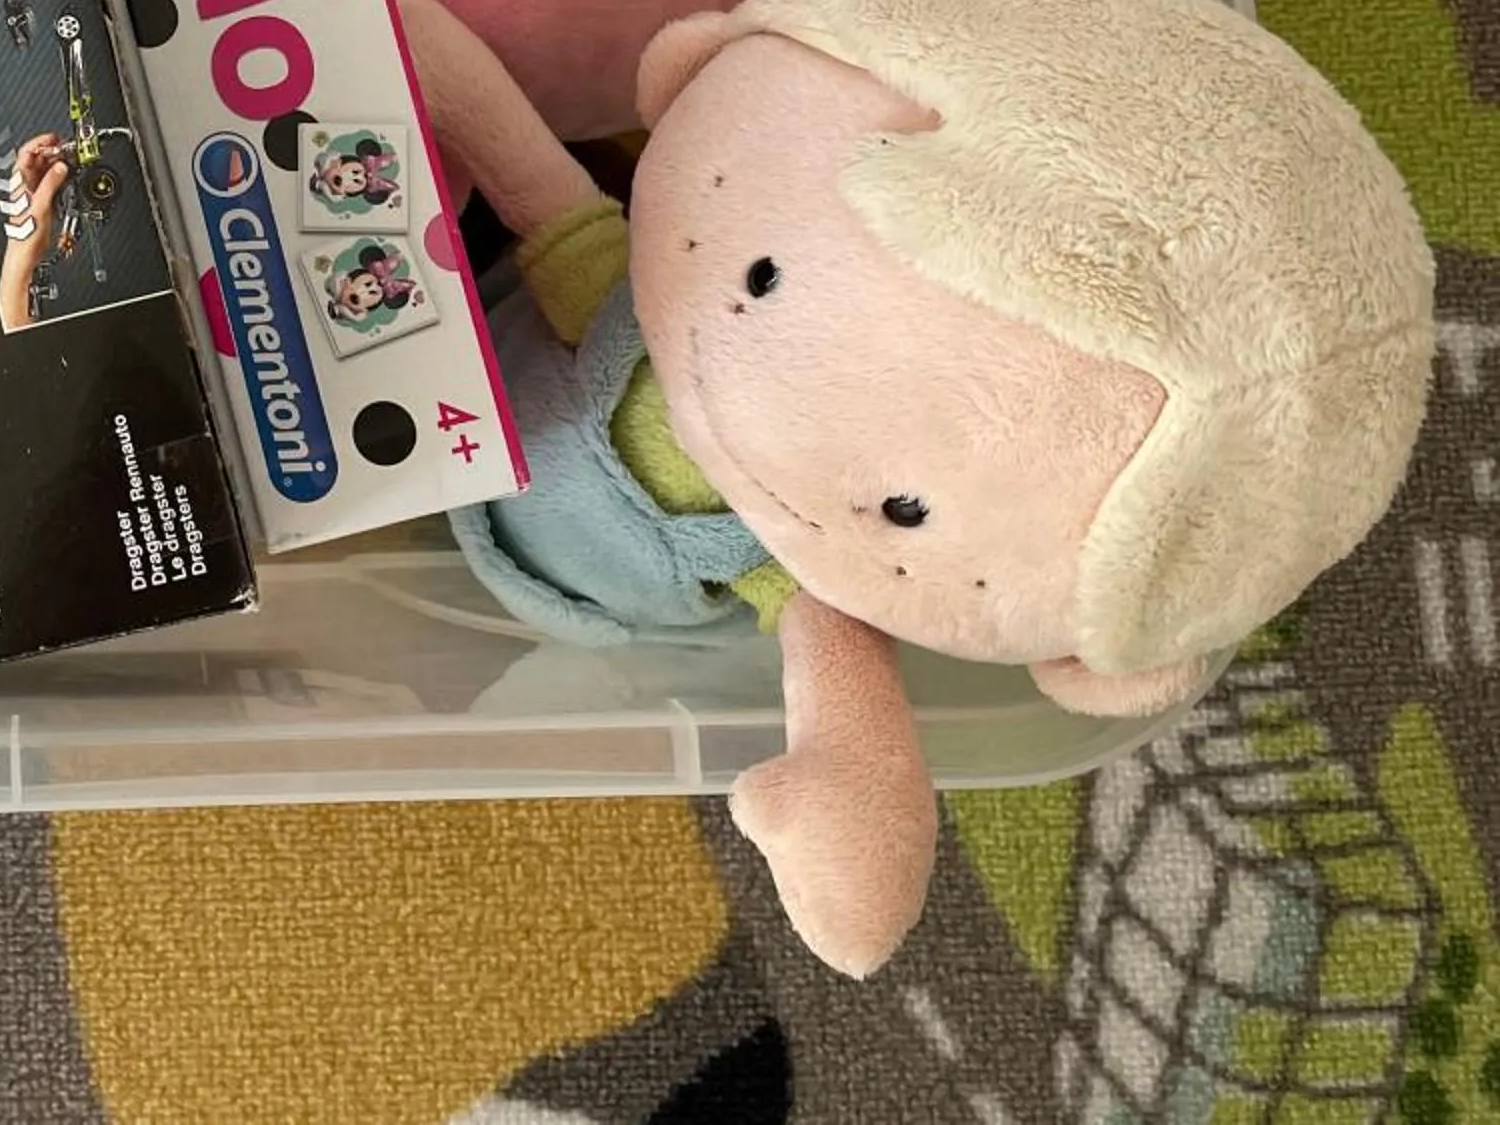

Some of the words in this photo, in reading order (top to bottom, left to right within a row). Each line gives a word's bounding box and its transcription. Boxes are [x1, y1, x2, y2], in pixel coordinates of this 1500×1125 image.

[219, 208, 326, 474] Clementoni
[114, 414, 146, 502] Rennauto
[436, 400, 482, 463] 4+
[117, 510, 148, 591] Dragster
[137, 506, 167, 586] Dragster
[150, 475, 180, 552] dragster
[175, 484, 207, 575] Dragsters
[172, 556, 187, 581] Le
